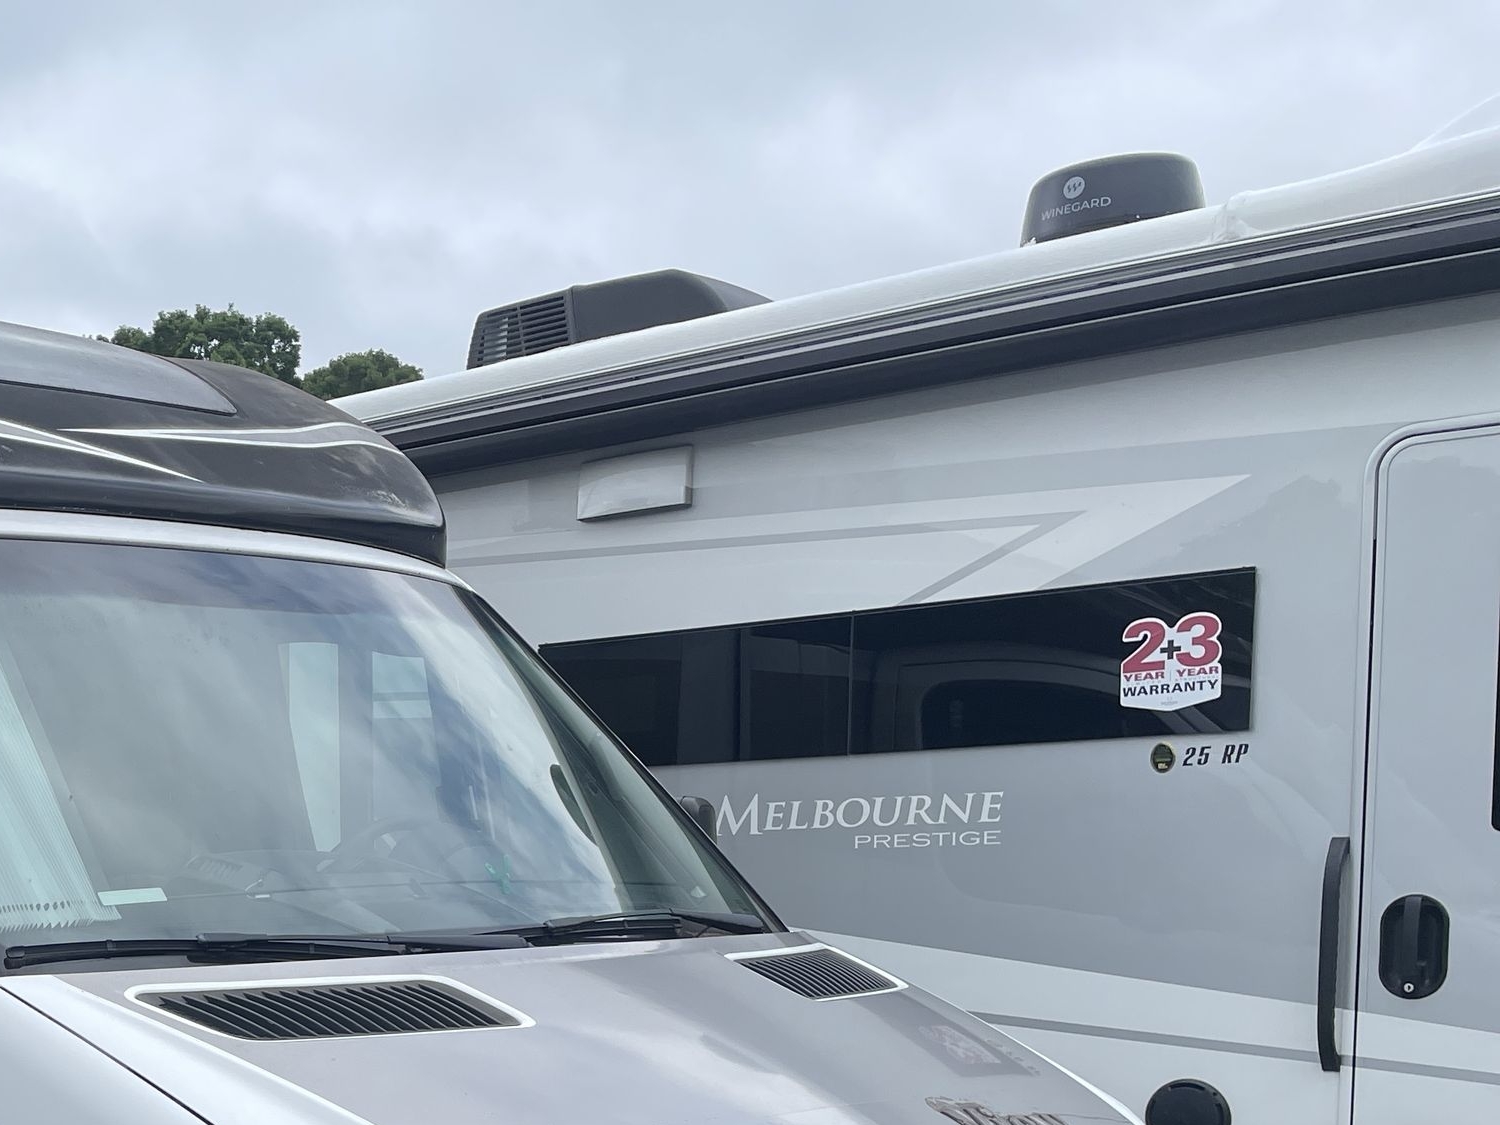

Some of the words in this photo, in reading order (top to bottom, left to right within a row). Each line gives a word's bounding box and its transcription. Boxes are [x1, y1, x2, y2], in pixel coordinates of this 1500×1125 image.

[1041, 197, 1112, 221] WINEGARD
[1123, 672, 1165, 682] YEAR
[1176, 666, 1219, 677] YEAR
[1122, 679, 1219, 697] WARRANTY
[1183, 746, 1211, 766] 25
[1221, 743, 1249, 764] RP
[854, 830, 1001, 849] PRESTIGE
